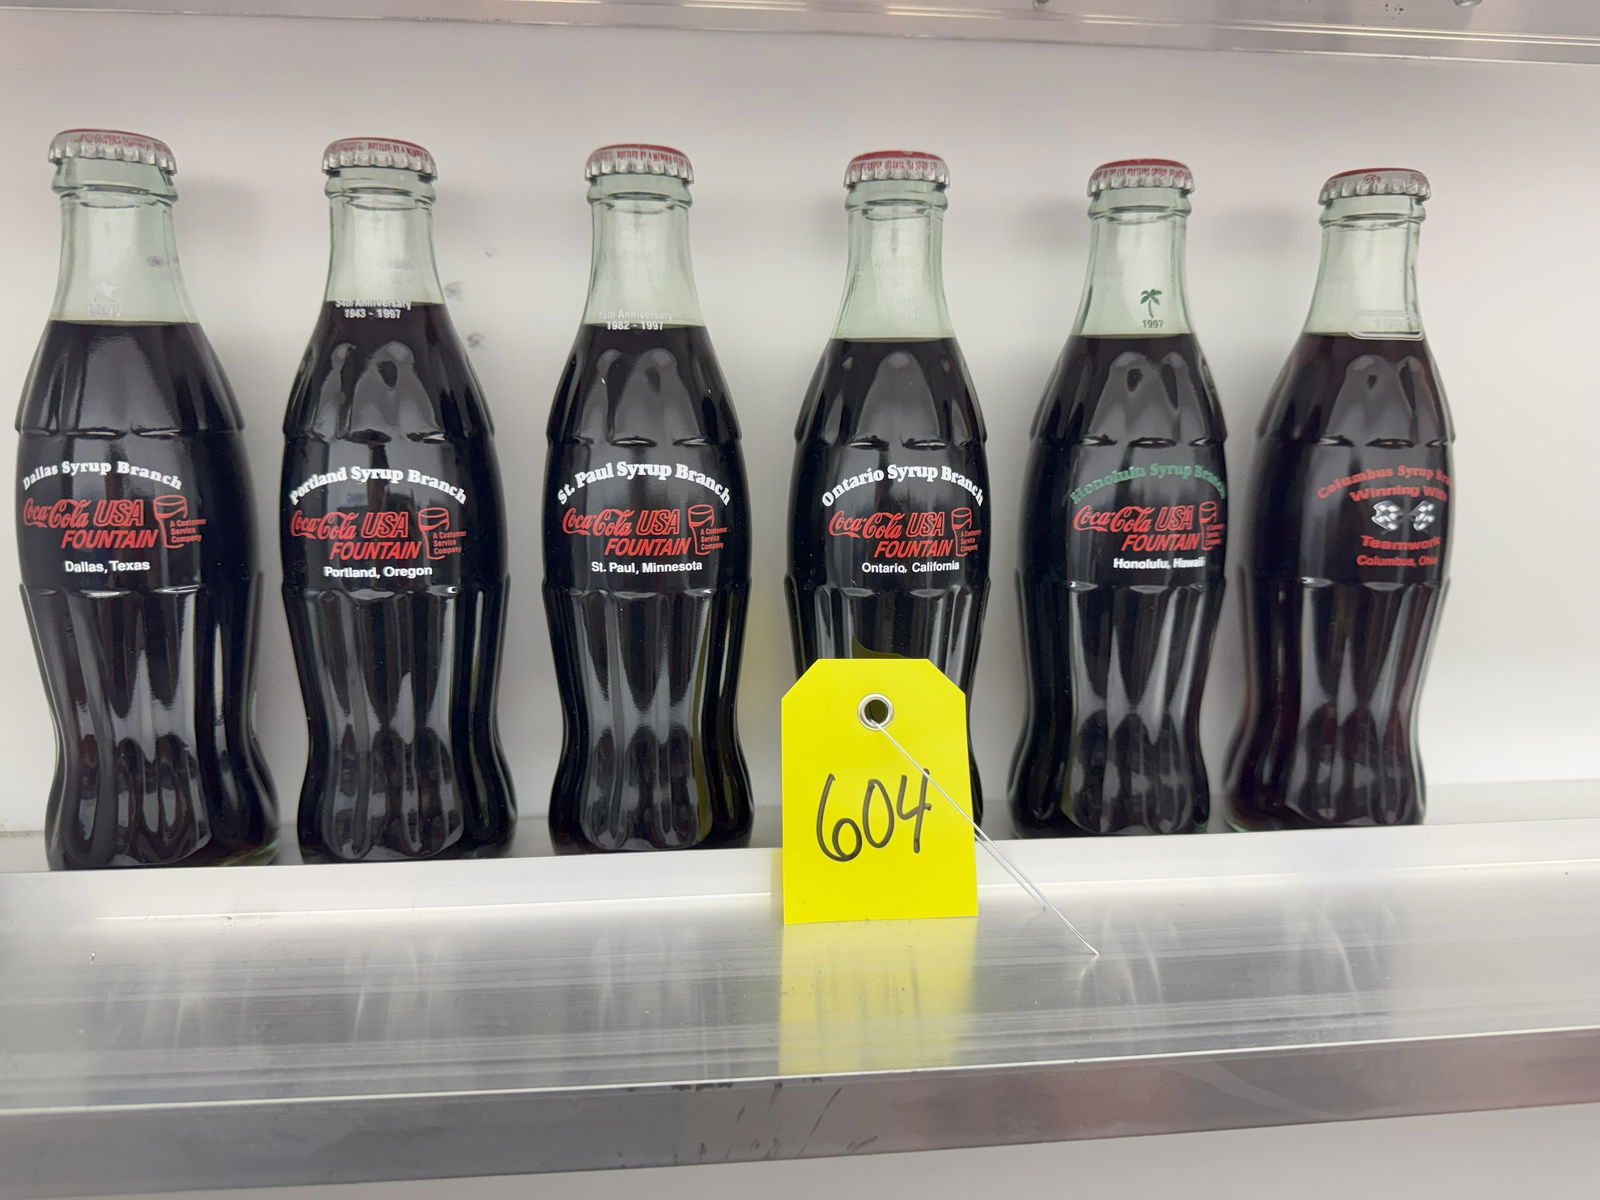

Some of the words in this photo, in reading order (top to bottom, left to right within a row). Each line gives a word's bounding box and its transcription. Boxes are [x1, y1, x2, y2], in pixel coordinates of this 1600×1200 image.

[344, 308, 367, 319] 1943
[376, 308, 401, 319] 1997
[618, 309, 672, 322] Anniversary
[607, 320, 630, 331] 1982
[641, 320, 664, 331] 1997
[1142, 319, 1164, 329] 1997
[22, 463, 59, 490] Dallas
[61, 460, 112, 476] Syrup
[117, 460, 182, 490] Branch
[1150, 463, 1193, 479] Syrup
[289, 466, 348, 506] Portland
[350, 466, 403, 484] Syrup
[407, 469, 467, 505] Branch
[557, 484, 576, 505] St.
[575, 462, 614, 489] Paul
[616, 461, 672, 481] Syrup
[675, 463, 731, 506] Branch
[821, 467, 885, 507] Ontario
[887, 463, 938, 483] Syrup
[940, 465, 983, 507] Branch
[1317, 467, 1394, 500] Columbus
[1397, 465, 1434, 481] Syrup
[1349, 485, 1420, 502] Winning
[23, 498, 91, 529] Coca-Cola
[93, 499, 144, 527] USA
[562, 507, 636, 537] Coca-Cola
[635, 509, 681, 536] USA
[1073, 505, 1155, 533] Coca-Cola
[1154, 505, 1194, 531] USA
[291, 510, 360, 540] Coca-Cola
[361, 511, 409, 539] USA
[828, 510, 906, 540] Coca-Cola
[905, 511, 945, 537] USA
[61, 529, 159, 550] FOUNTAIN
[433, 532, 439, 540] A
[433, 539, 457, 548] Service
[1120, 532, 1200, 552] FOUNTAIN
[1360, 535, 1441, 551] Teamwork
[329, 541, 422, 561] FOUNTAIN
[434, 546, 462, 556] Company
[604, 537, 692, 557] FOUNTAIN
[873, 539, 954, 559] FOUNTAIN
[65, 560, 108, 574] Dallas,
[109, 560, 151, 572] Texas
[591, 561, 604, 573] St.
[609, 562, 639, 575] Paul,
[642, 561, 703, 573] Minnesota
[861, 562, 908, 574] Ontario,
[912, 561, 960, 573] California
[1113, 558, 1171, 570] Honolulu,
[1173, 556, 1206, 568] Hawaii
[1356, 554, 1417, 568] Columbus,
[323, 566, 380, 579] Portland,
[383, 565, 433, 579] Oregon
[816, 768, 932, 863] 604
